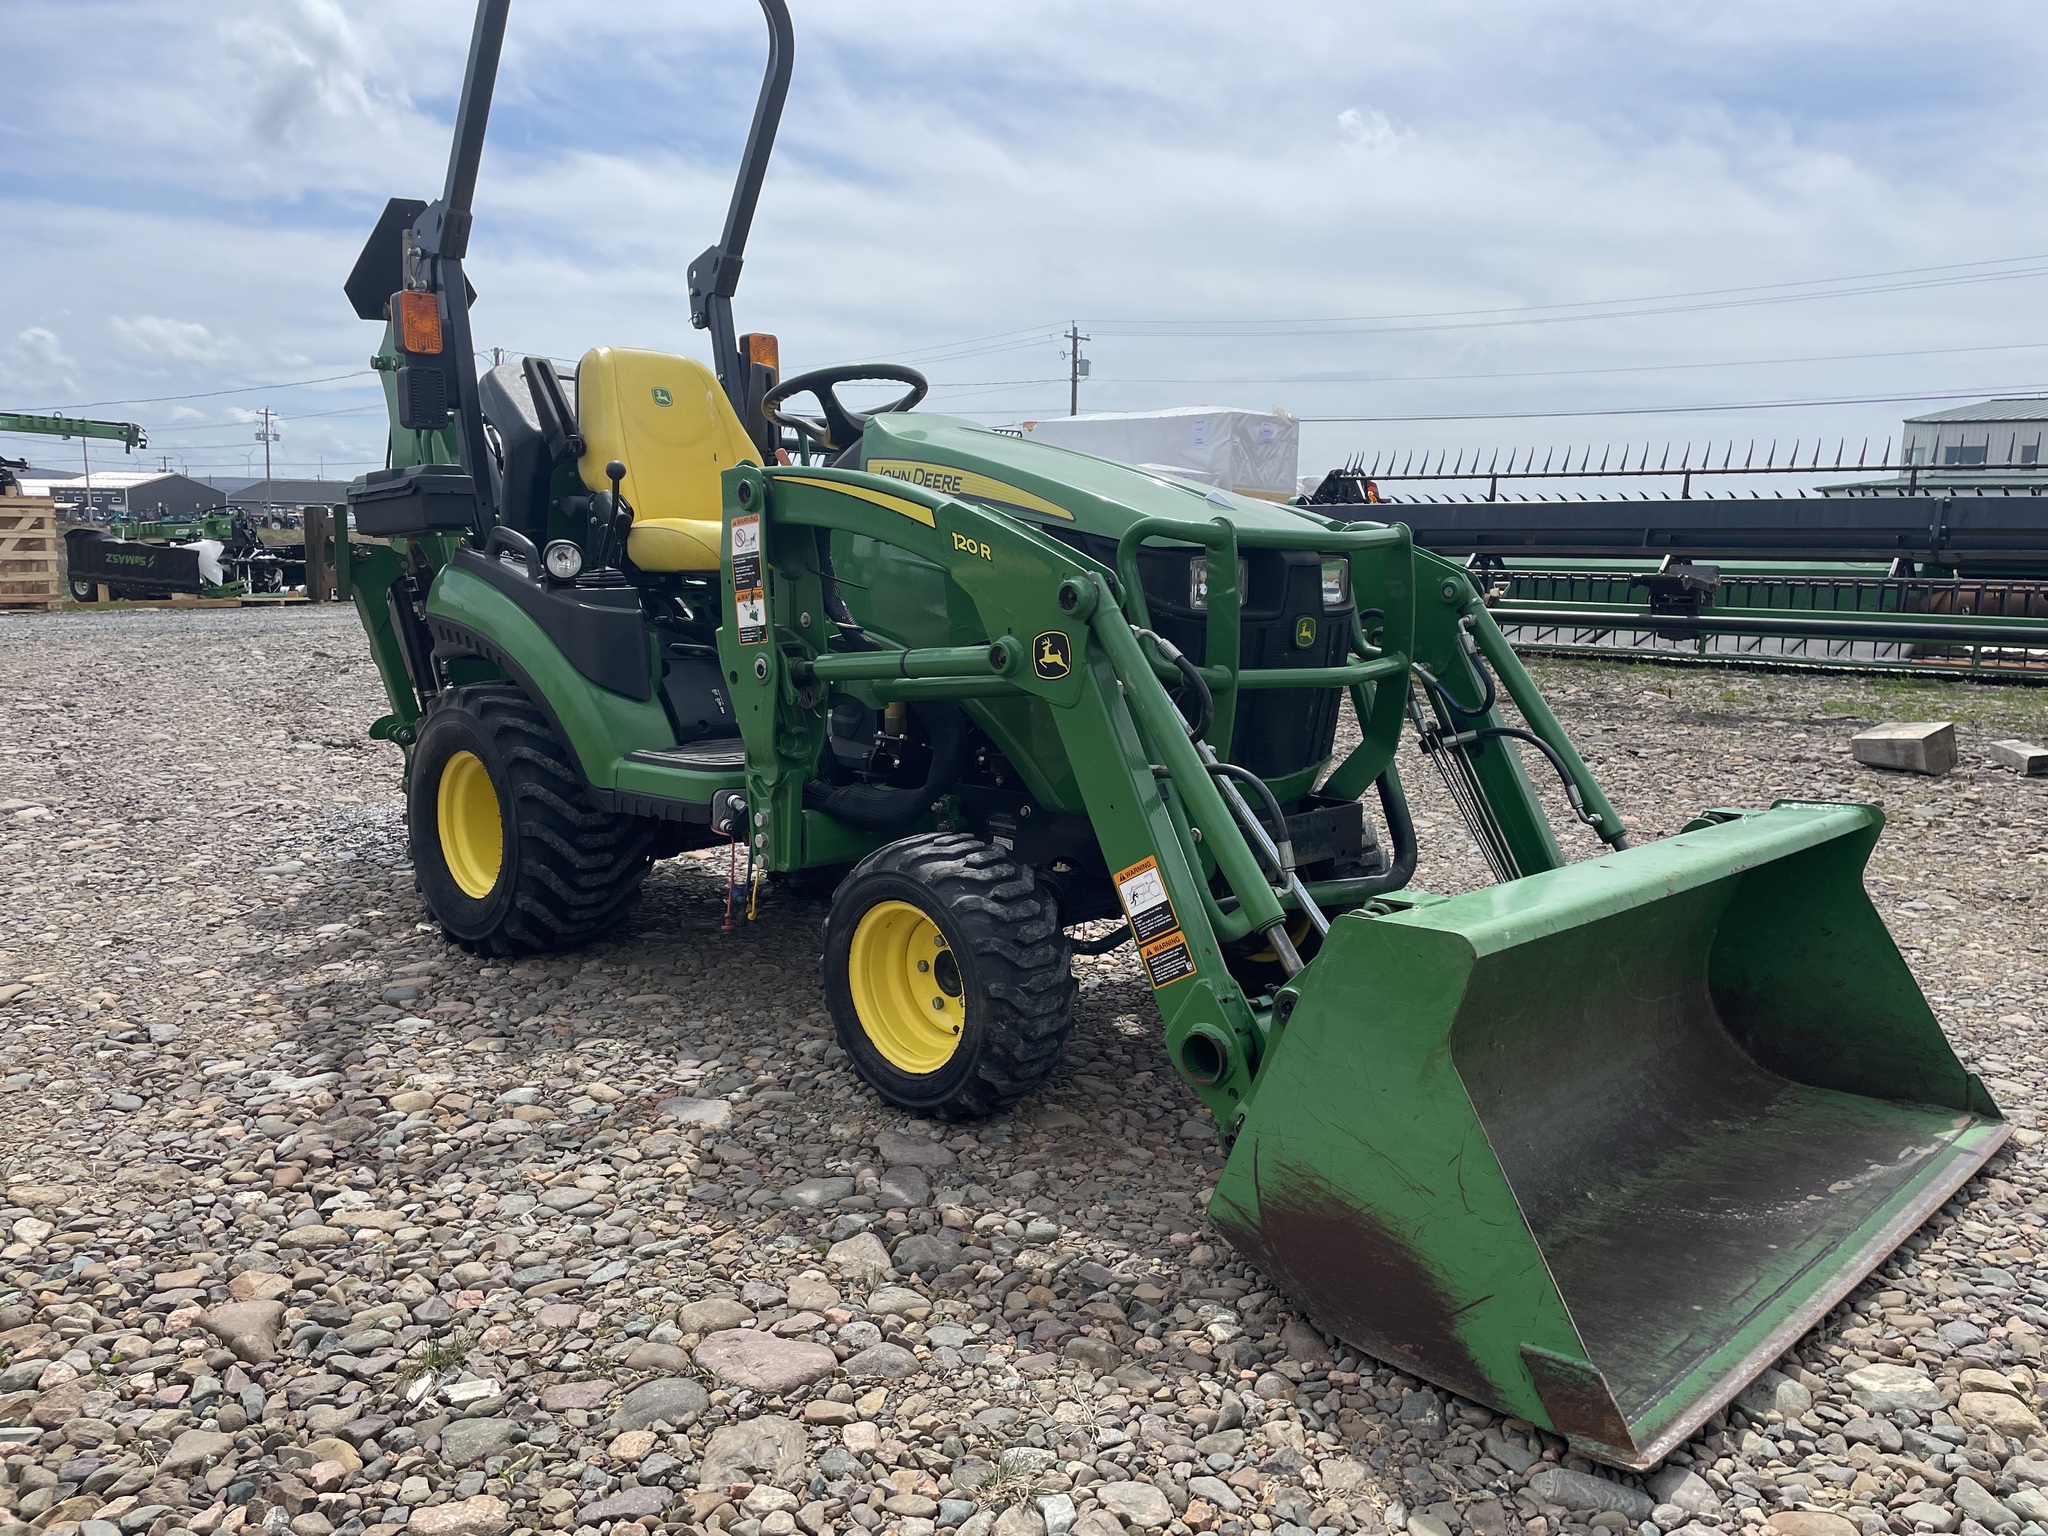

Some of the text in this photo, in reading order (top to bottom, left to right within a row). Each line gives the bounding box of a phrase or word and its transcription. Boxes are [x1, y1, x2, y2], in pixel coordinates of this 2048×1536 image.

[913, 467, 962, 492] DEERE
[736, 514, 759, 525] WARNING
[1125, 861, 1152, 878] WARNING
[1153, 936, 1181, 952] WARNING
